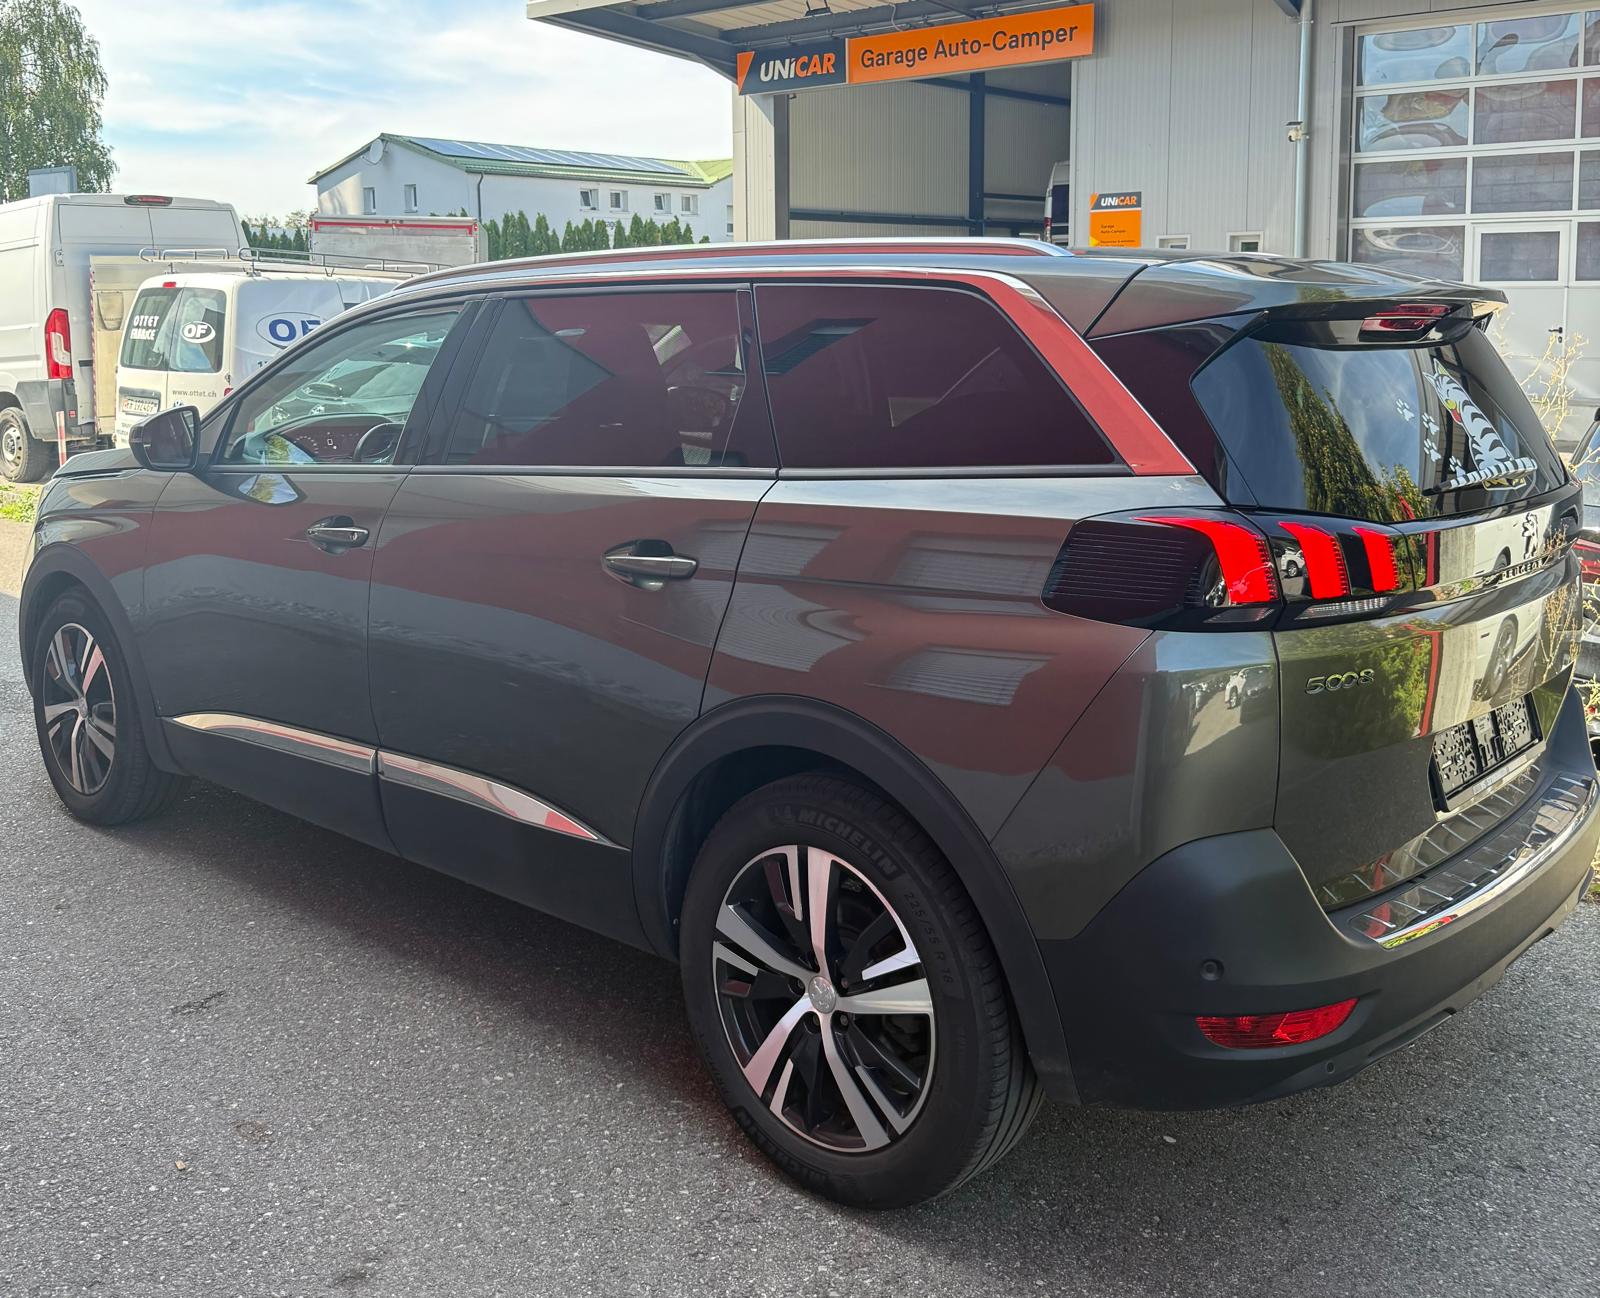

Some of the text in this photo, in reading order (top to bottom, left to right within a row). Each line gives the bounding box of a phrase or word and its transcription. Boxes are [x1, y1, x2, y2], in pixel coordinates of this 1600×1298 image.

[861, 26, 1079, 68] Garage Auto-Camper
[133, 314, 160, 328] OTTET
[183, 323, 208, 338] OF
[172, 389, 217, 400] www.ottet.ch
[1305, 668, 1375, 695] 5008
[797, 806, 898, 875] MICHELIN
